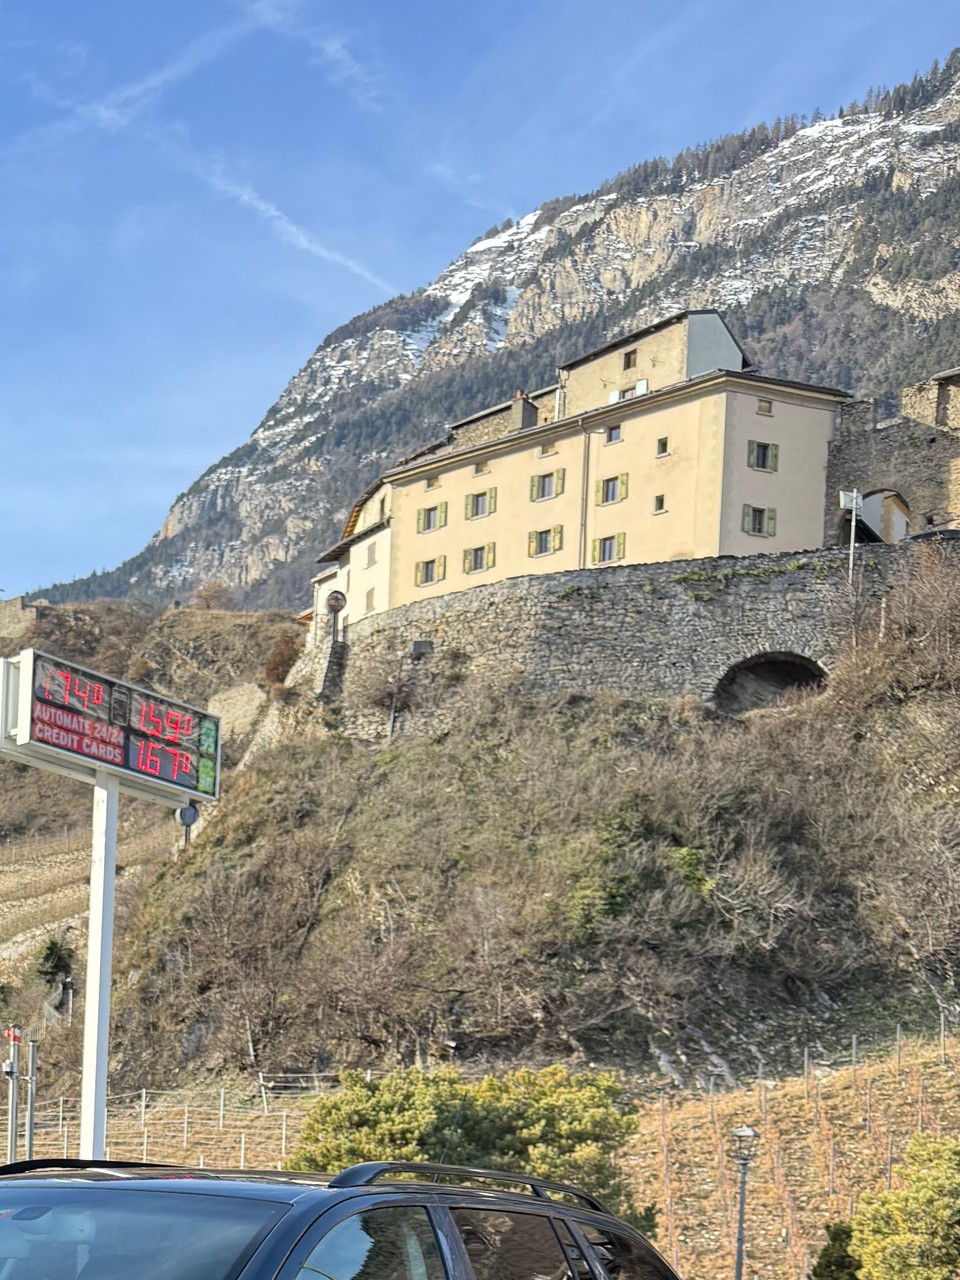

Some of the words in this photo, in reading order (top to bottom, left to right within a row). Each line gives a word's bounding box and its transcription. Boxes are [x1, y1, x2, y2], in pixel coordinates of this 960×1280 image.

[35, 704, 92, 734] AUTOMATE
[94, 722, 125, 746] 24/24
[35, 722, 79, 749] CREDIT
[82, 738, 121, 763] CARDS
